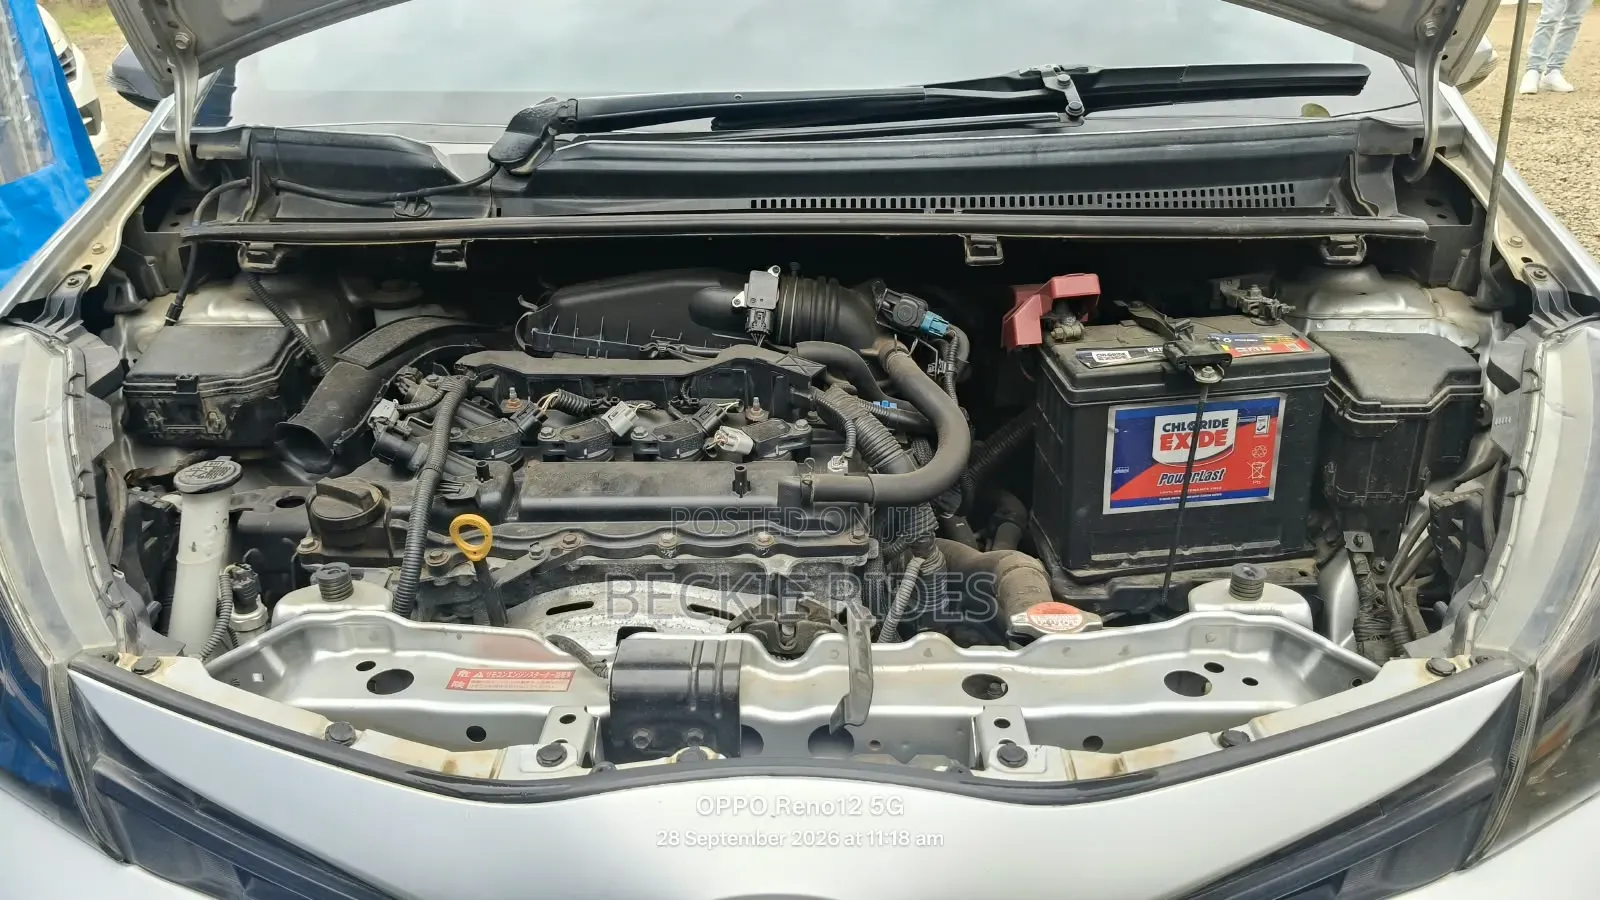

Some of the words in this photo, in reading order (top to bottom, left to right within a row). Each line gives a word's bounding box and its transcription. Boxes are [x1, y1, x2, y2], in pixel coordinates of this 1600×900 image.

[1162, 418, 1230, 433] CHLORIDE
[1160, 428, 1229, 451] EXDE
[1156, 467, 1227, 487] PowrLast
